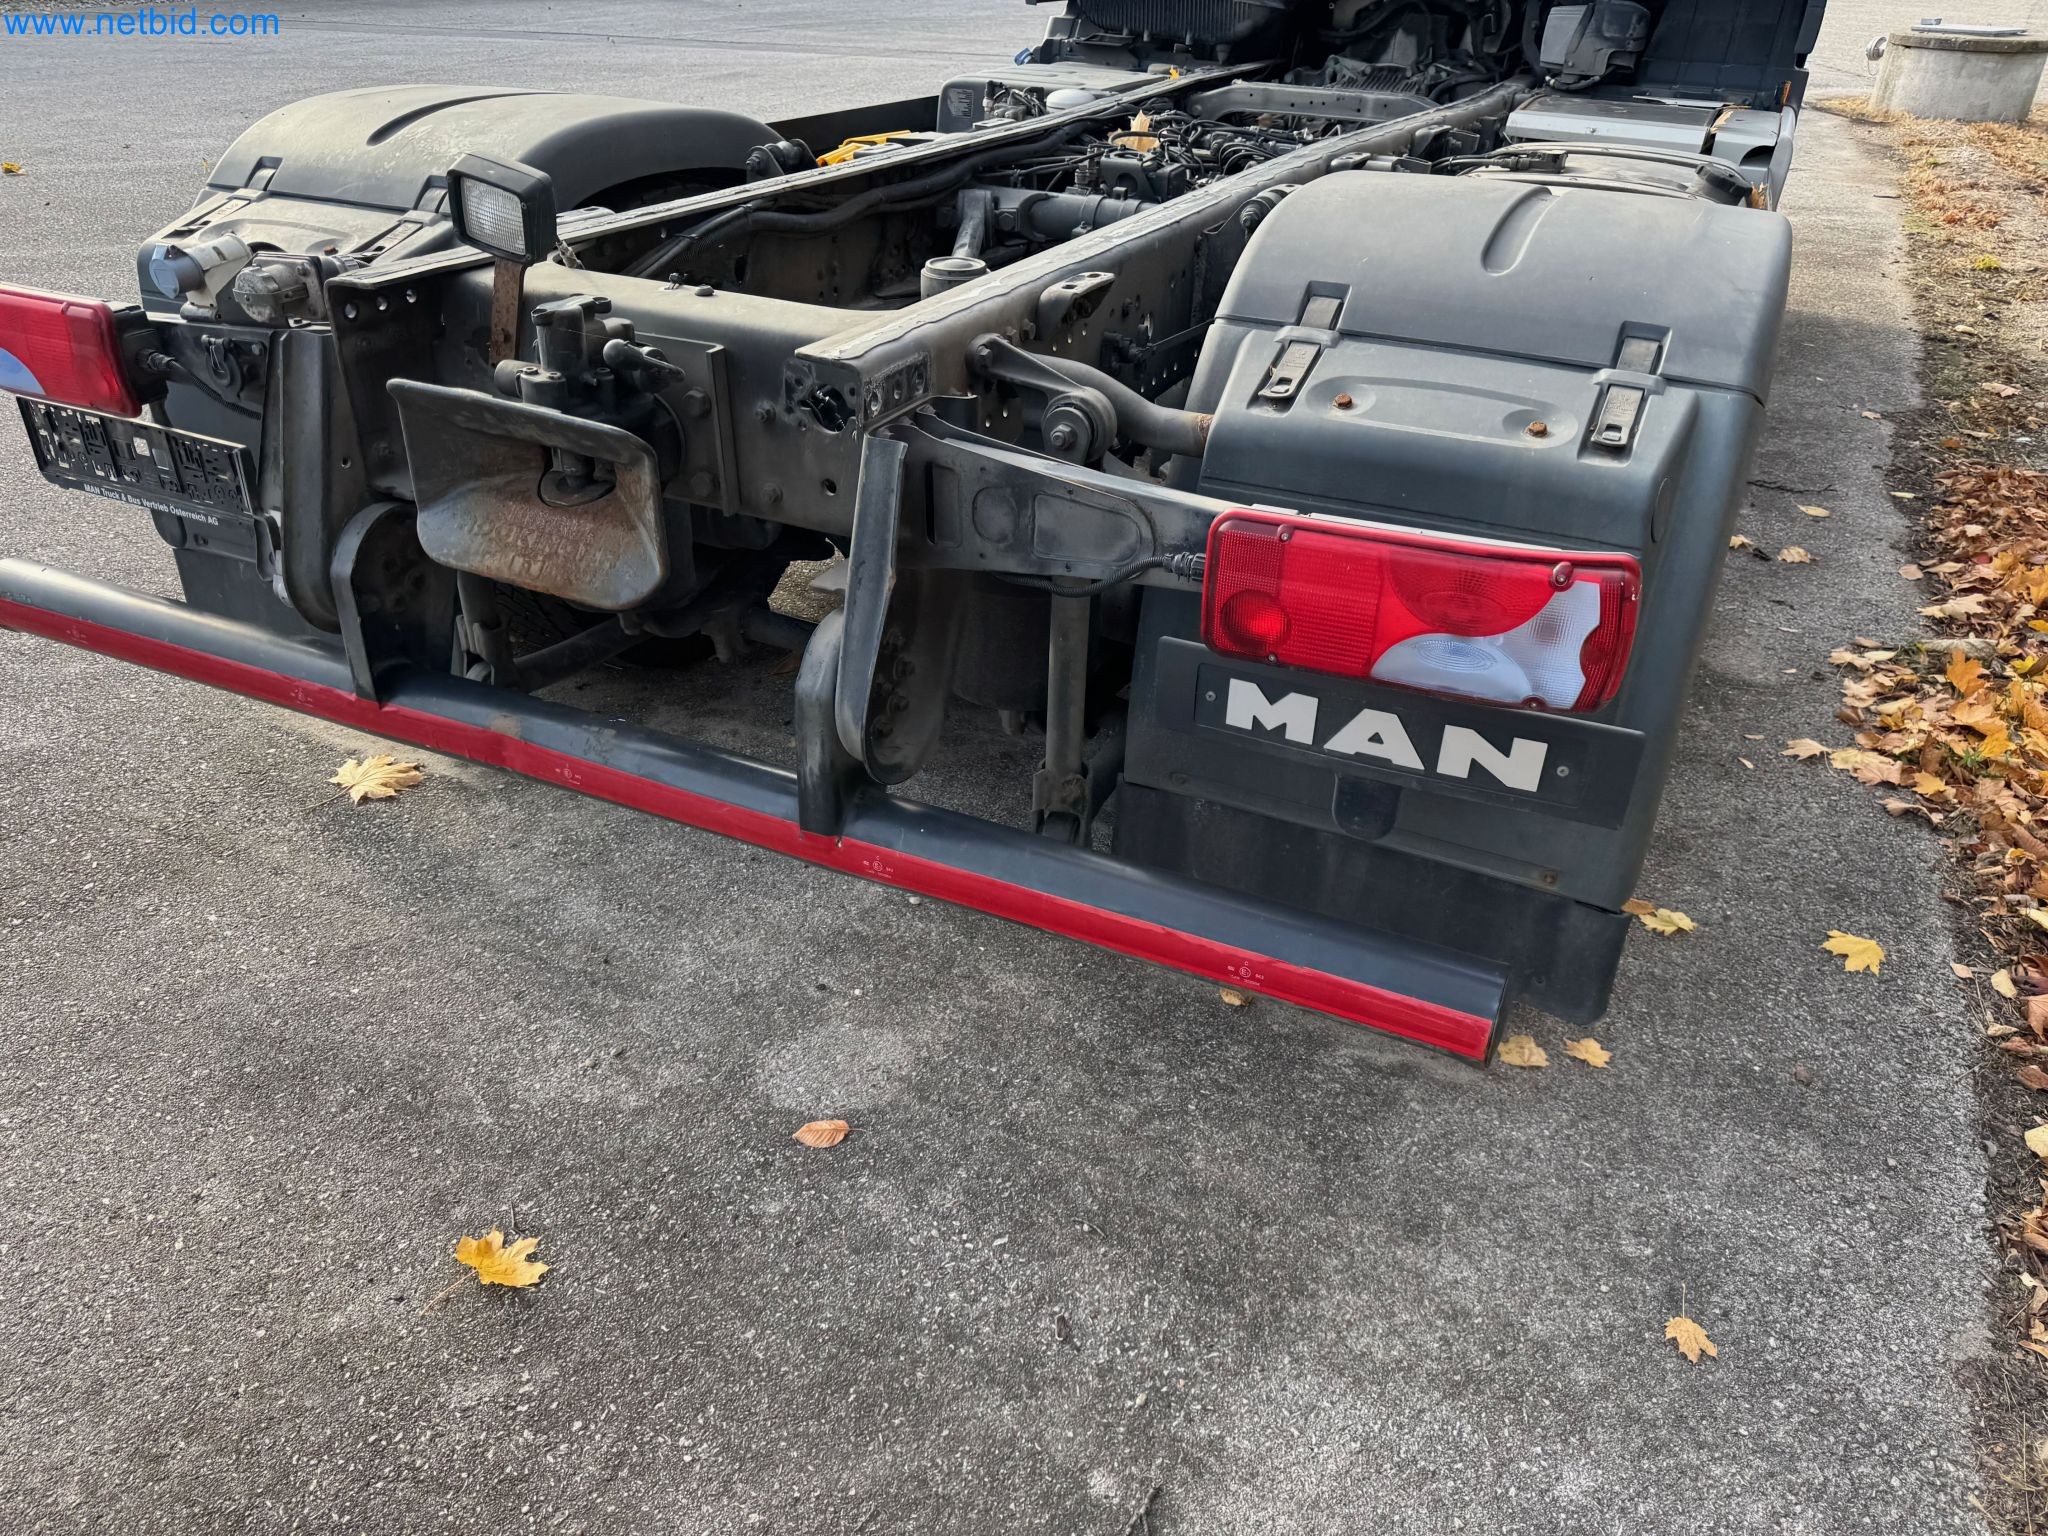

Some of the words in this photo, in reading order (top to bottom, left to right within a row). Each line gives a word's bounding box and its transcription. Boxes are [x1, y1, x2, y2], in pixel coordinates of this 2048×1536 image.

[84, 483, 100, 495] MAN
[102, 487, 120, 499] Truck
[121, 493, 127, 501] &
[127, 495, 141, 505] Bus
[142, 498, 169, 513] Vertrieb
[170, 503, 207, 522] Österreich
[207, 516, 219, 526] AG
[1225, 677, 1549, 793] MAN
